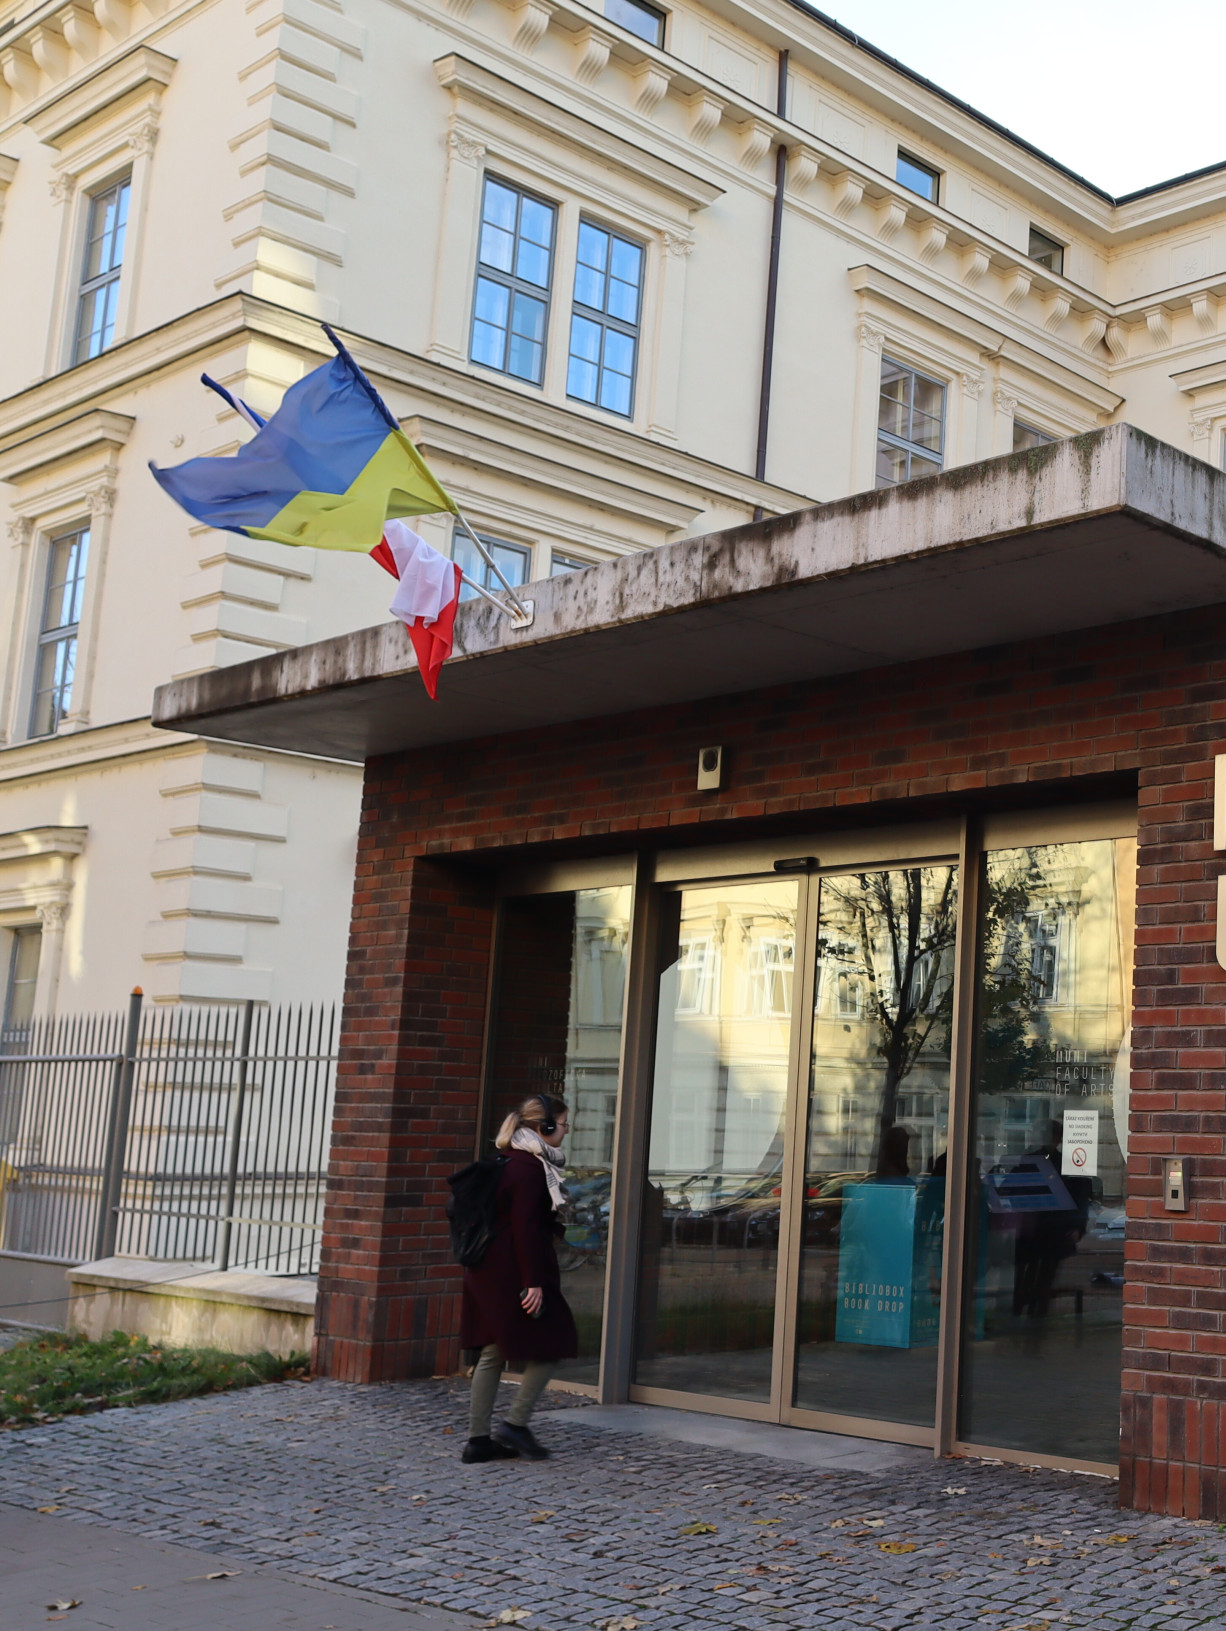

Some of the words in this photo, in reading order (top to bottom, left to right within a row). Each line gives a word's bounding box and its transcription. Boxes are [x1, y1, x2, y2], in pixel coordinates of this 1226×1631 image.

[1056, 1050, 1088, 1063] MUNI
[1056, 1066, 1115, 1080] FACULTY
[1055, 1083, 1070, 1097] OF
[1081, 1083, 1114, 1097] ARTS
[844, 1282, 905, 1298] BIBLIOBOX
[844, 1298, 869, 1310] BOOK
[877, 1300, 905, 1313] DROP
